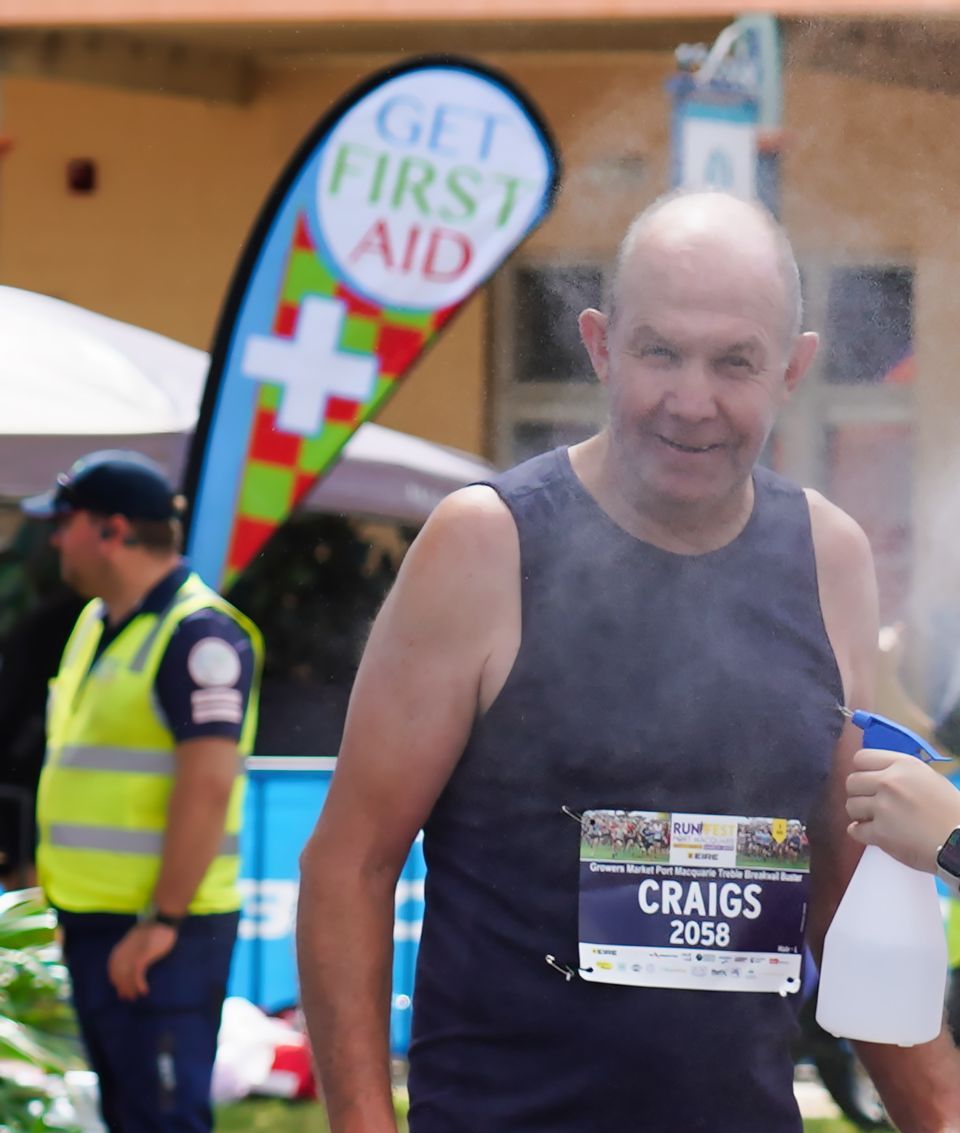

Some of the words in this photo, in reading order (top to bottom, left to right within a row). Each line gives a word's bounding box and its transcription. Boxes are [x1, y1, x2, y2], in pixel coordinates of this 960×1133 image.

[375, 92, 511, 162] GET
[327, 141, 537, 228] FIRST
[348, 215, 475, 284] AID
[589, 862, 625, 873] Growers
[626, 863, 655, 875] Market
[655, 864, 673, 875] Port
[674, 866, 717, 878] Macquarie
[638, 879, 762, 920] CRAIGS
[669, 920, 730, 948] 2058
